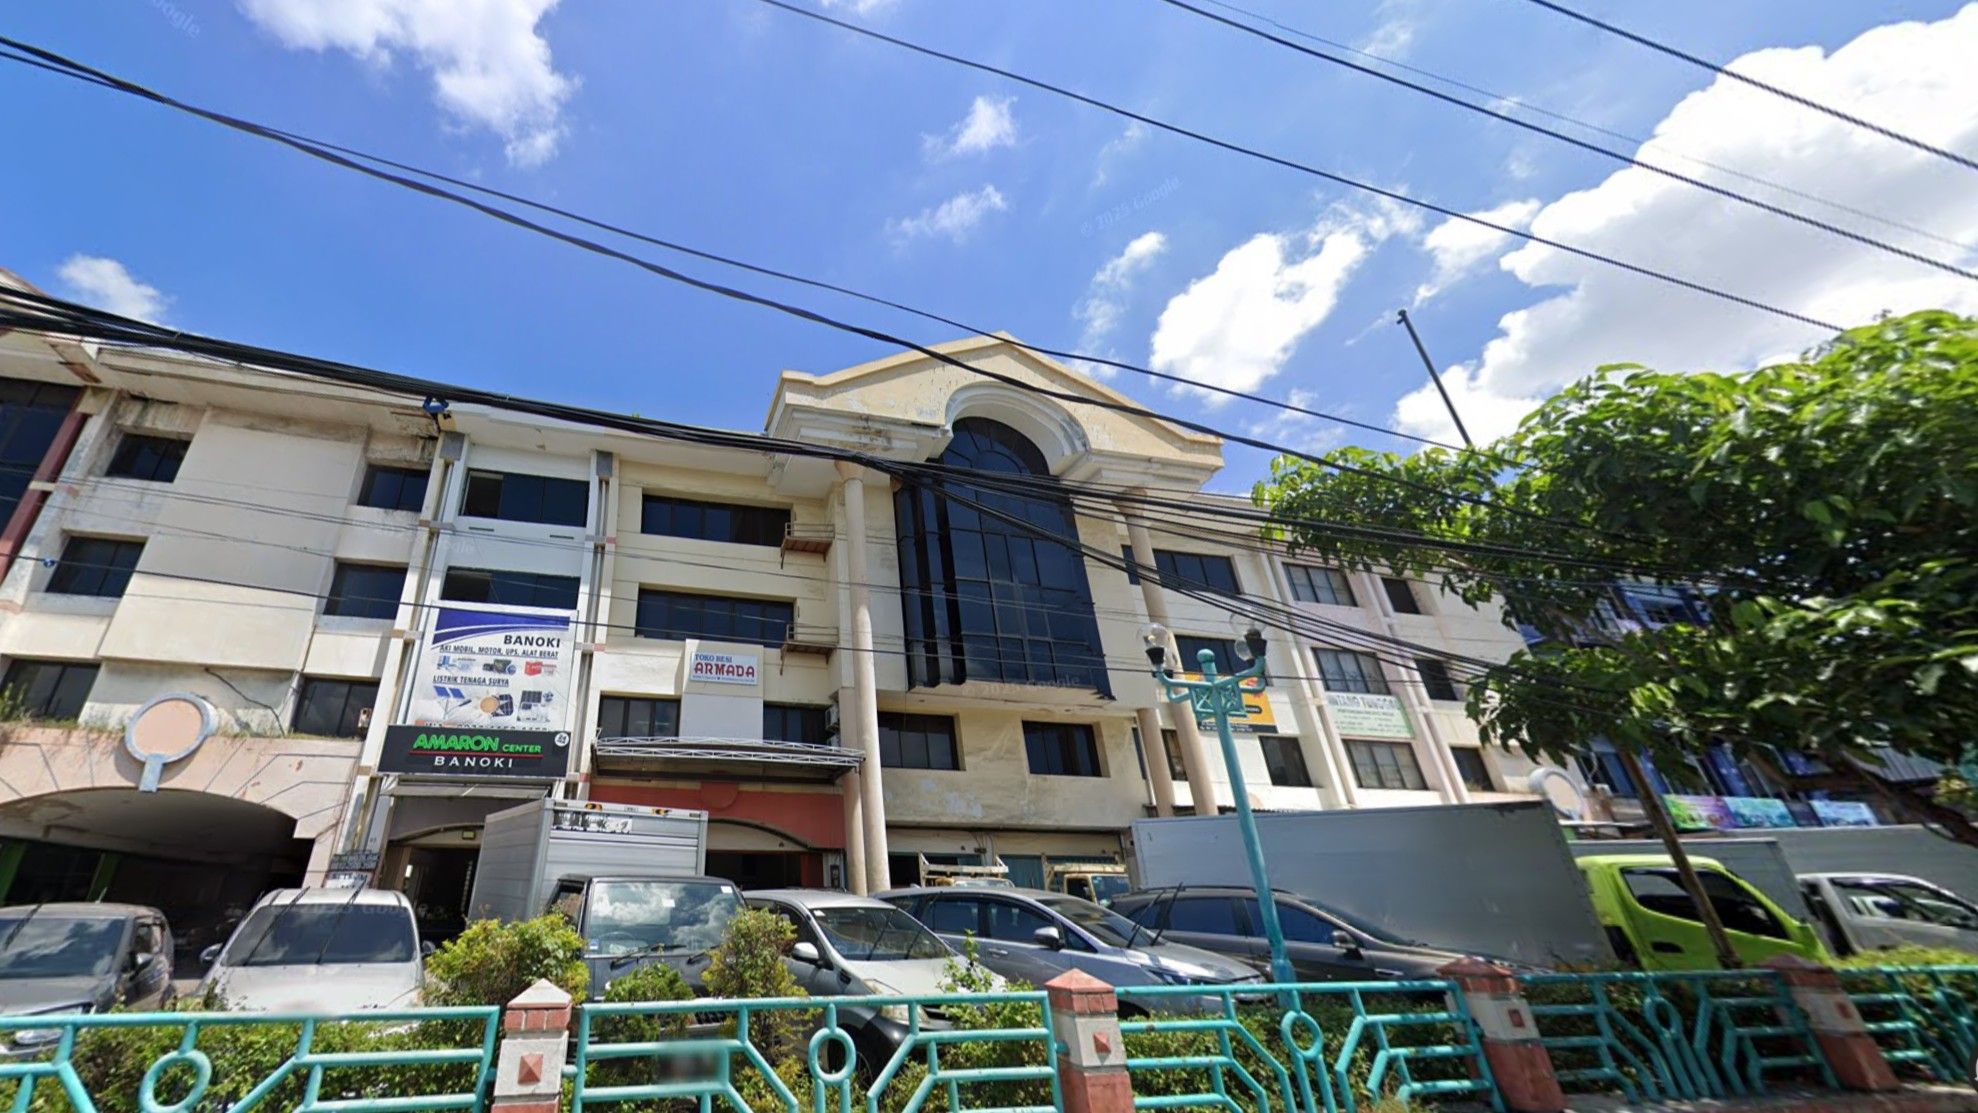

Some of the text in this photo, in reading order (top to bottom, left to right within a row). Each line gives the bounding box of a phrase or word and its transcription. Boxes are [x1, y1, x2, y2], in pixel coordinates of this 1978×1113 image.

[503, 634, 561, 648] BANOKI
[440, 644, 452, 652] AKI
[453, 645, 476, 653] MOBIL,
[478, 646, 503, 655] MOTOR,
[522, 649, 537, 657] ALAT
[540, 650, 559, 658] BERAT
[695, 653, 733, 663] TOKO BESI
[694, 662, 755, 678] ARMADA
[433, 674, 509, 686] LISTRIK TENAGA SURYA
[412, 733, 542, 753] AMARON CENTER
[434, 756, 513, 768] BANOKI
